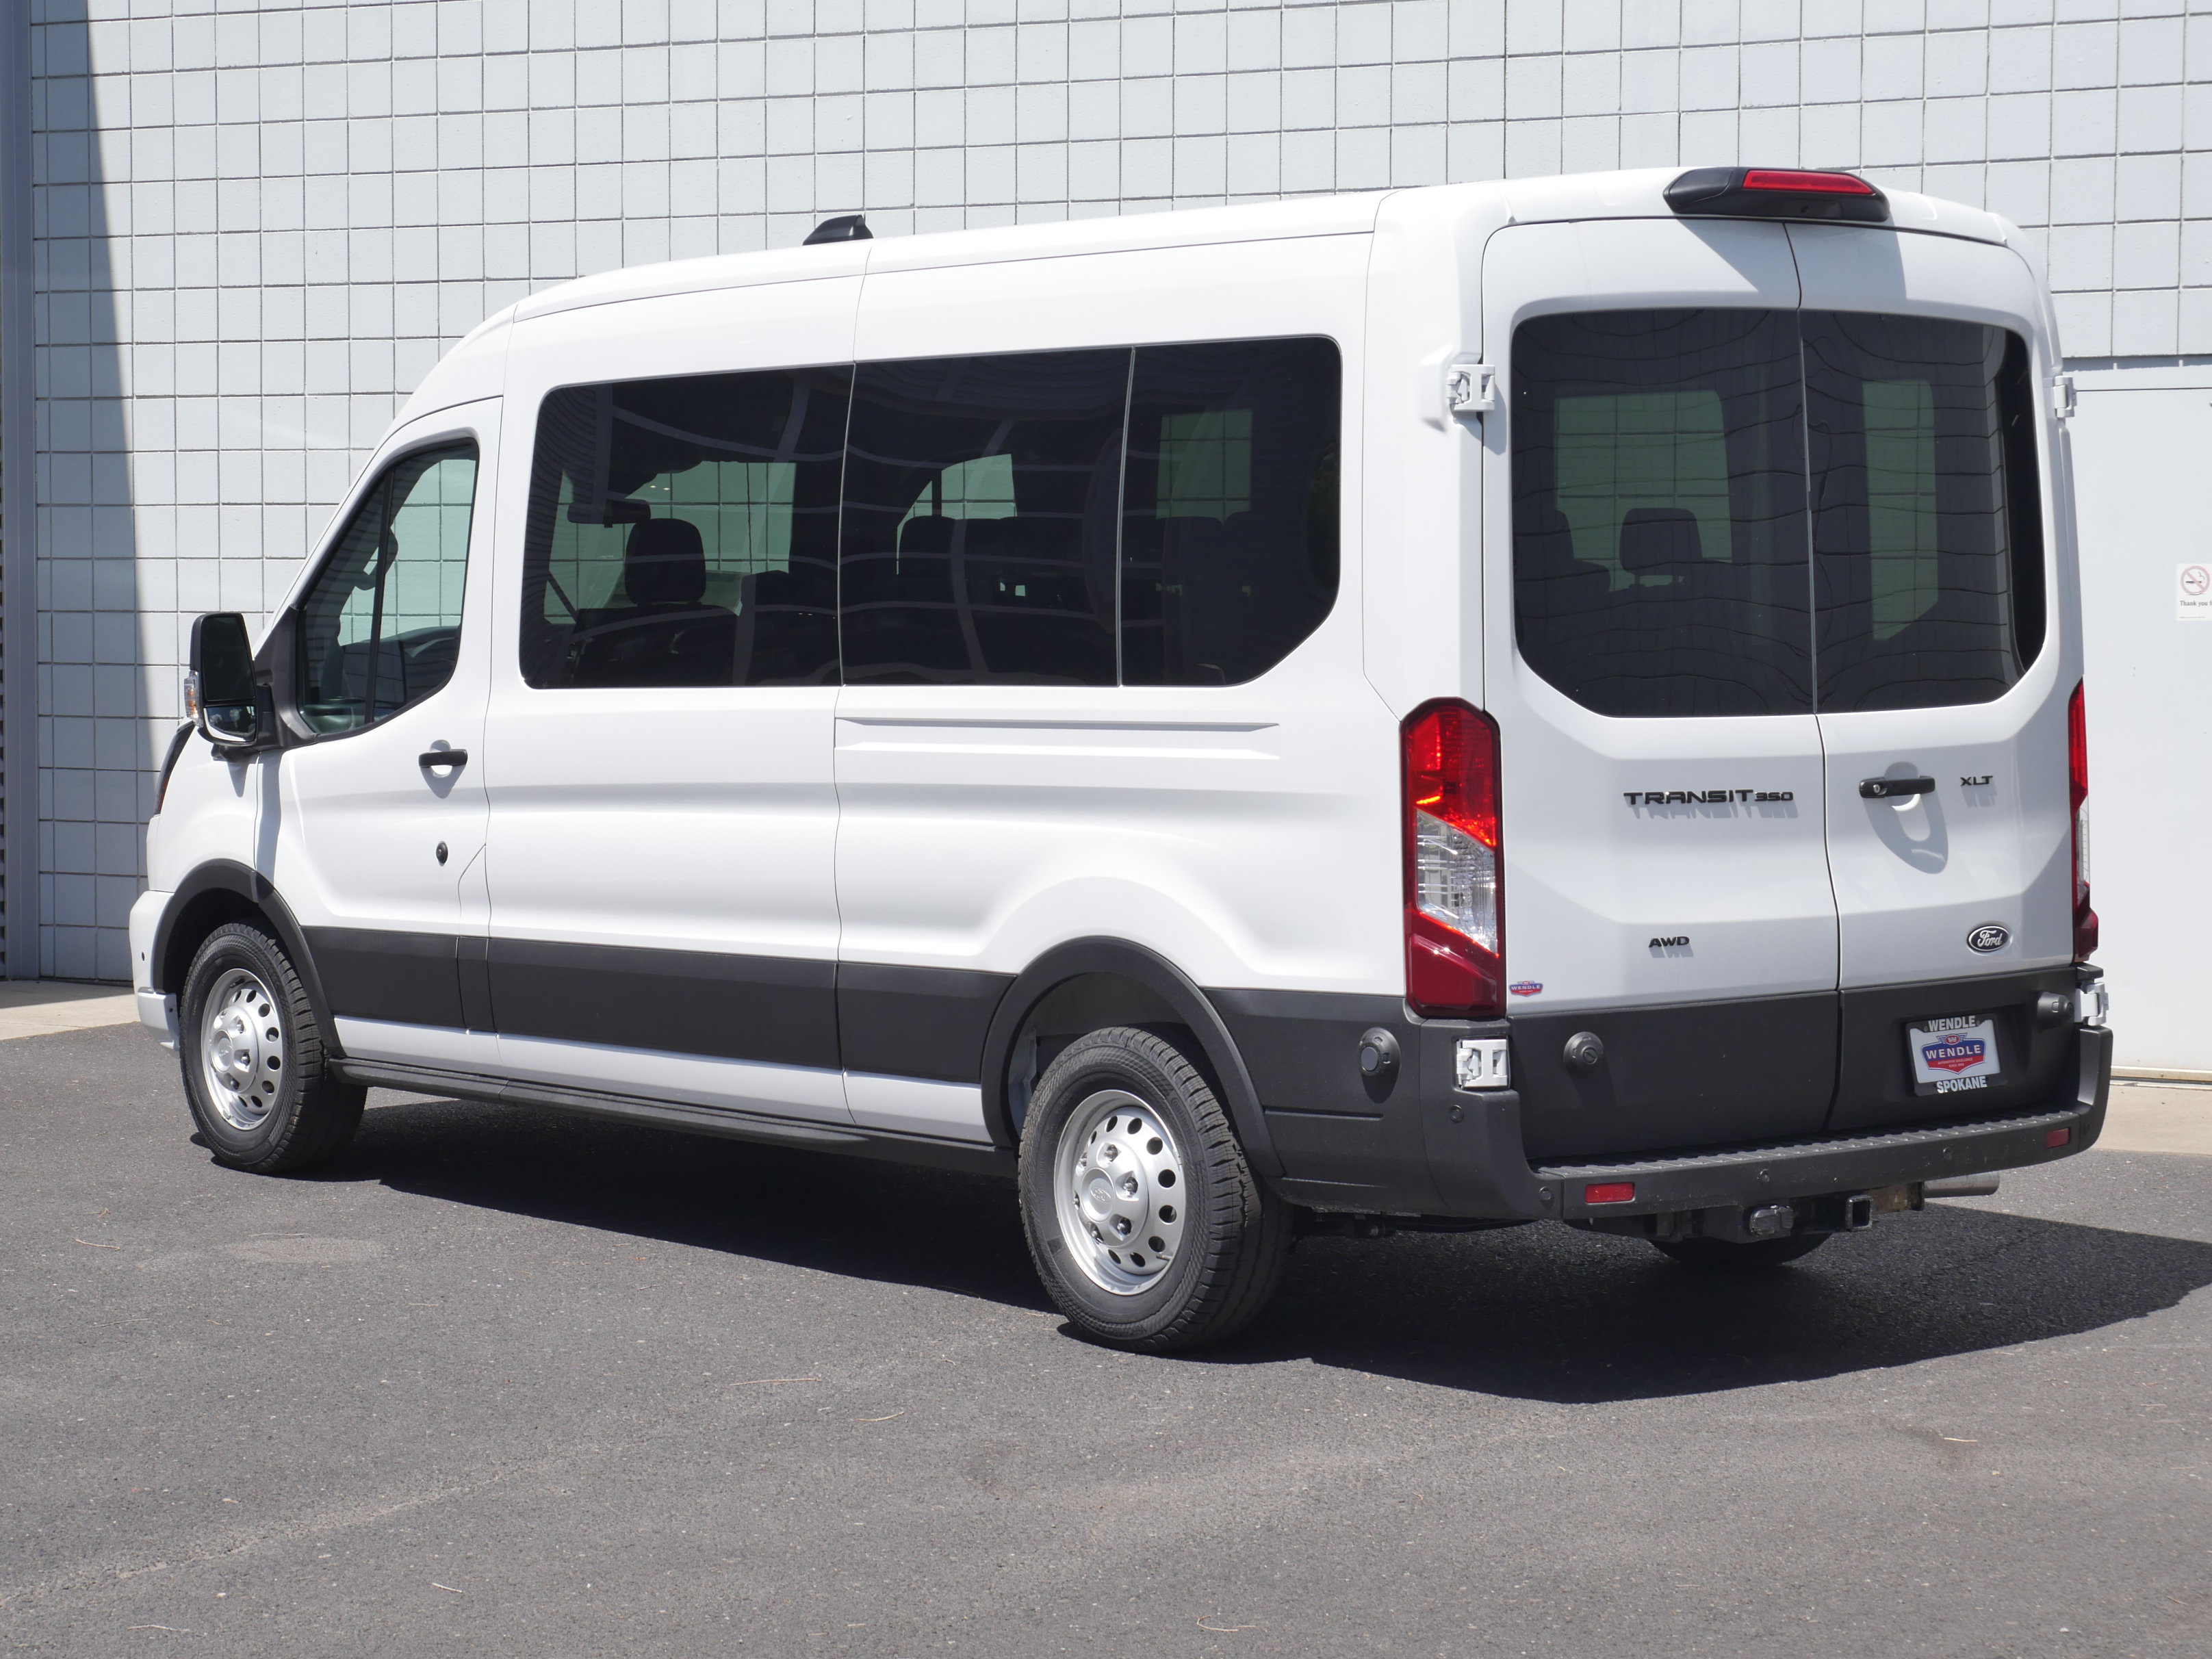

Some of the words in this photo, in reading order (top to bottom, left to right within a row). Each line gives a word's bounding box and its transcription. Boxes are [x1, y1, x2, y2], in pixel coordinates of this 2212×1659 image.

[1960, 775, 1993, 786] XLT
[1648, 936, 1690, 948] AWD
[1977, 929, 2003, 947] Ford
[1928, 1015, 1976, 1032] WENDLE
[1926, 1044, 1981, 1059] WENDLE
[1936, 1076, 1988, 1094] SPOKANE
